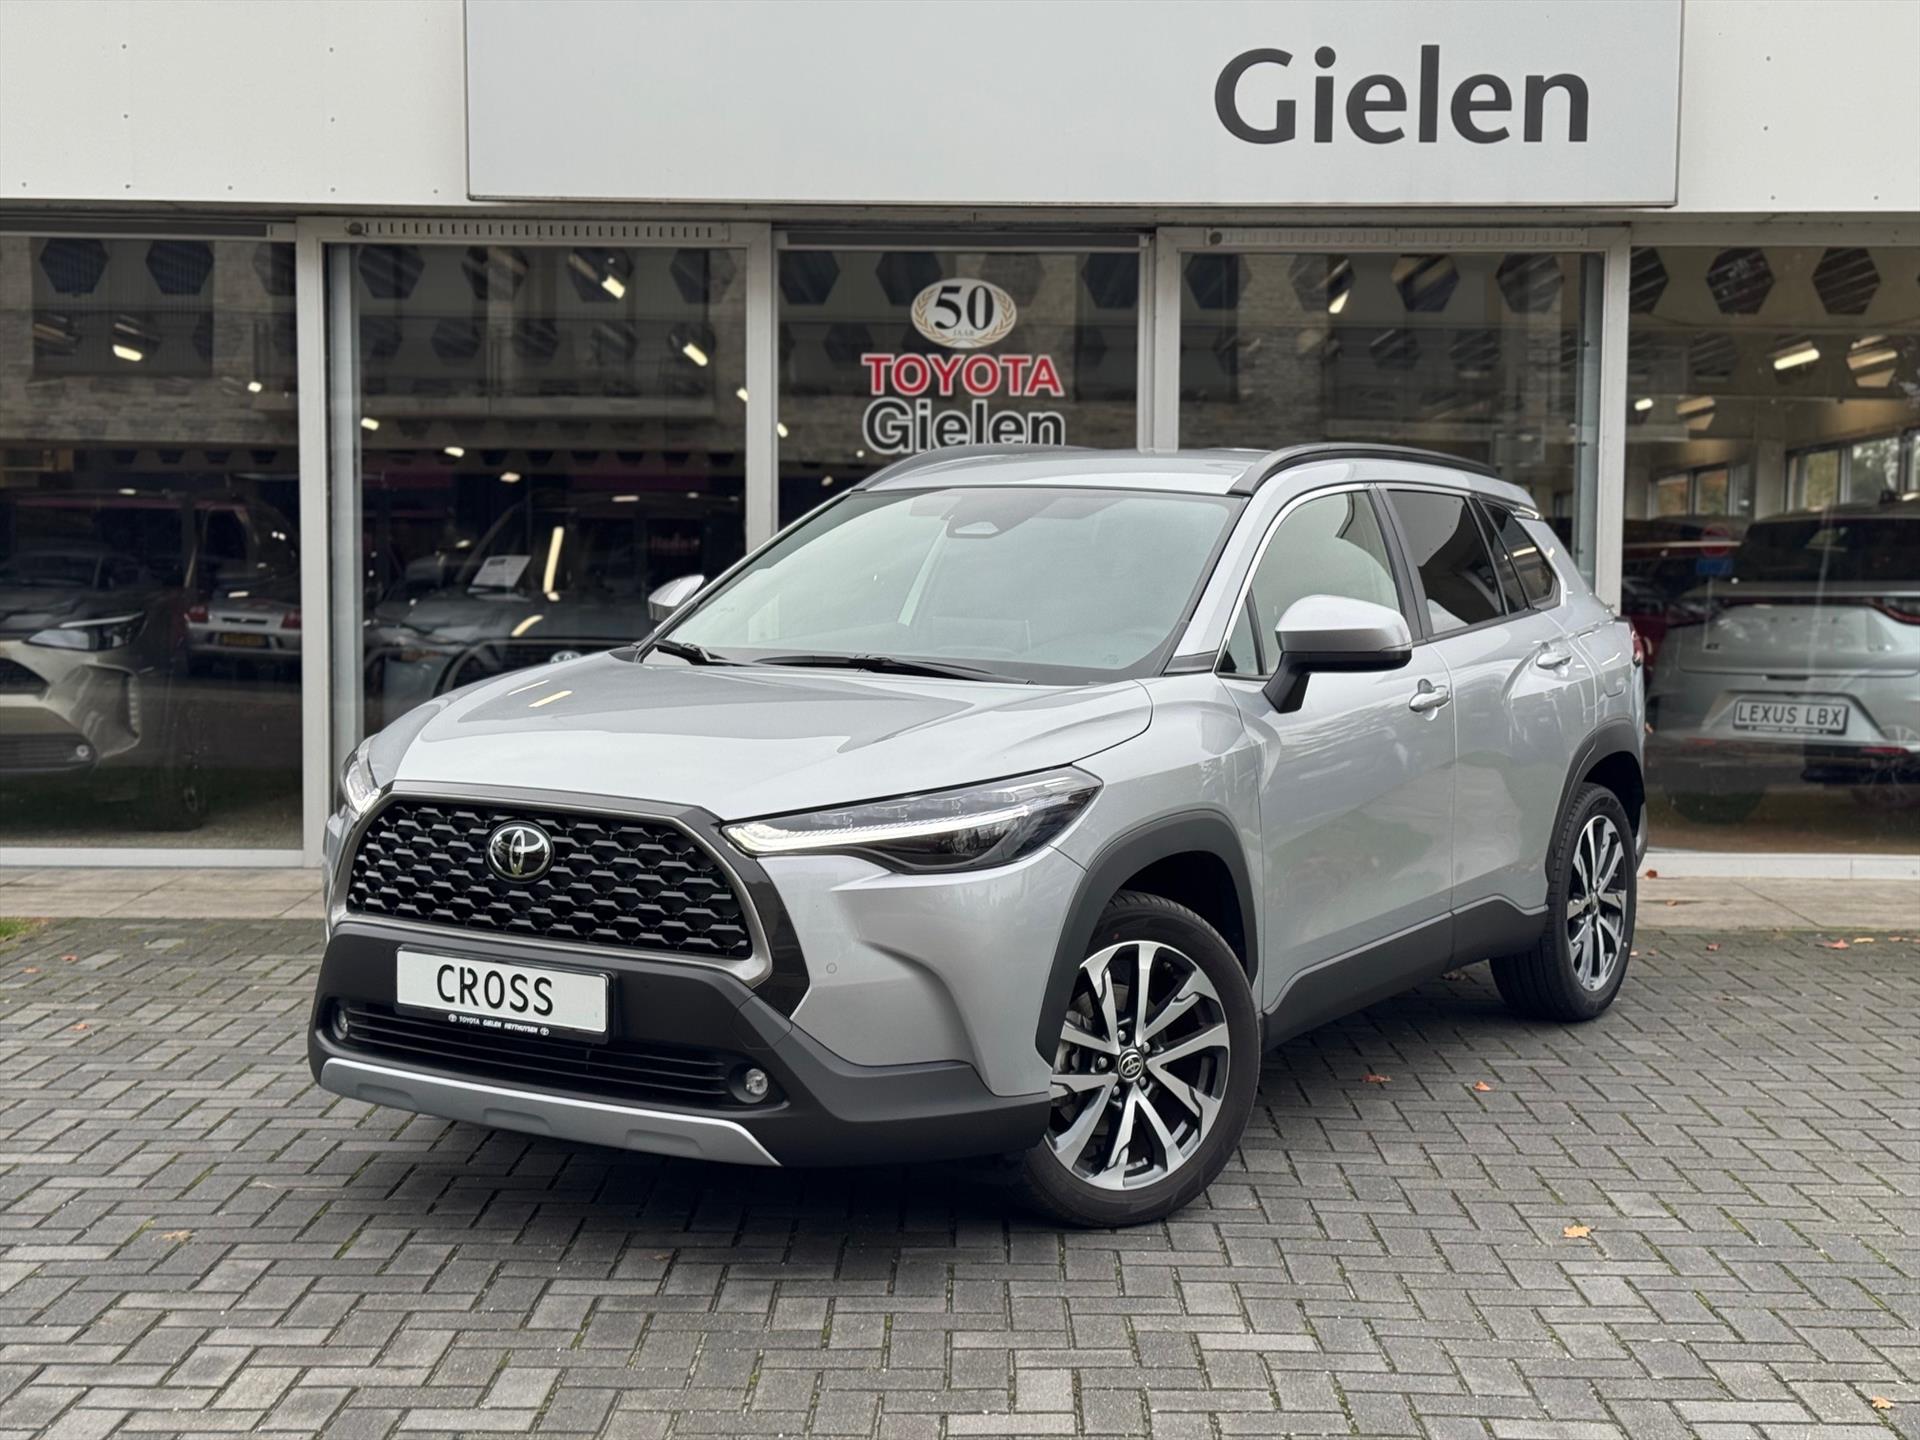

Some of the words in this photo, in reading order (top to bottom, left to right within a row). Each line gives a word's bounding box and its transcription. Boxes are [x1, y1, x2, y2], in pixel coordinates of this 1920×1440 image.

[1214, 44, 1589, 144] Gielen
[933, 285, 995, 331] 50
[861, 353, 1065, 397] TOYOTA
[862, 397, 1066, 454] Gielen
[1737, 704, 1798, 725] LEXUS
[1805, 707, 1842, 727] LBX
[436, 963, 553, 1017] CROSS
[458, 1015, 480, 1025] TOYOTA
